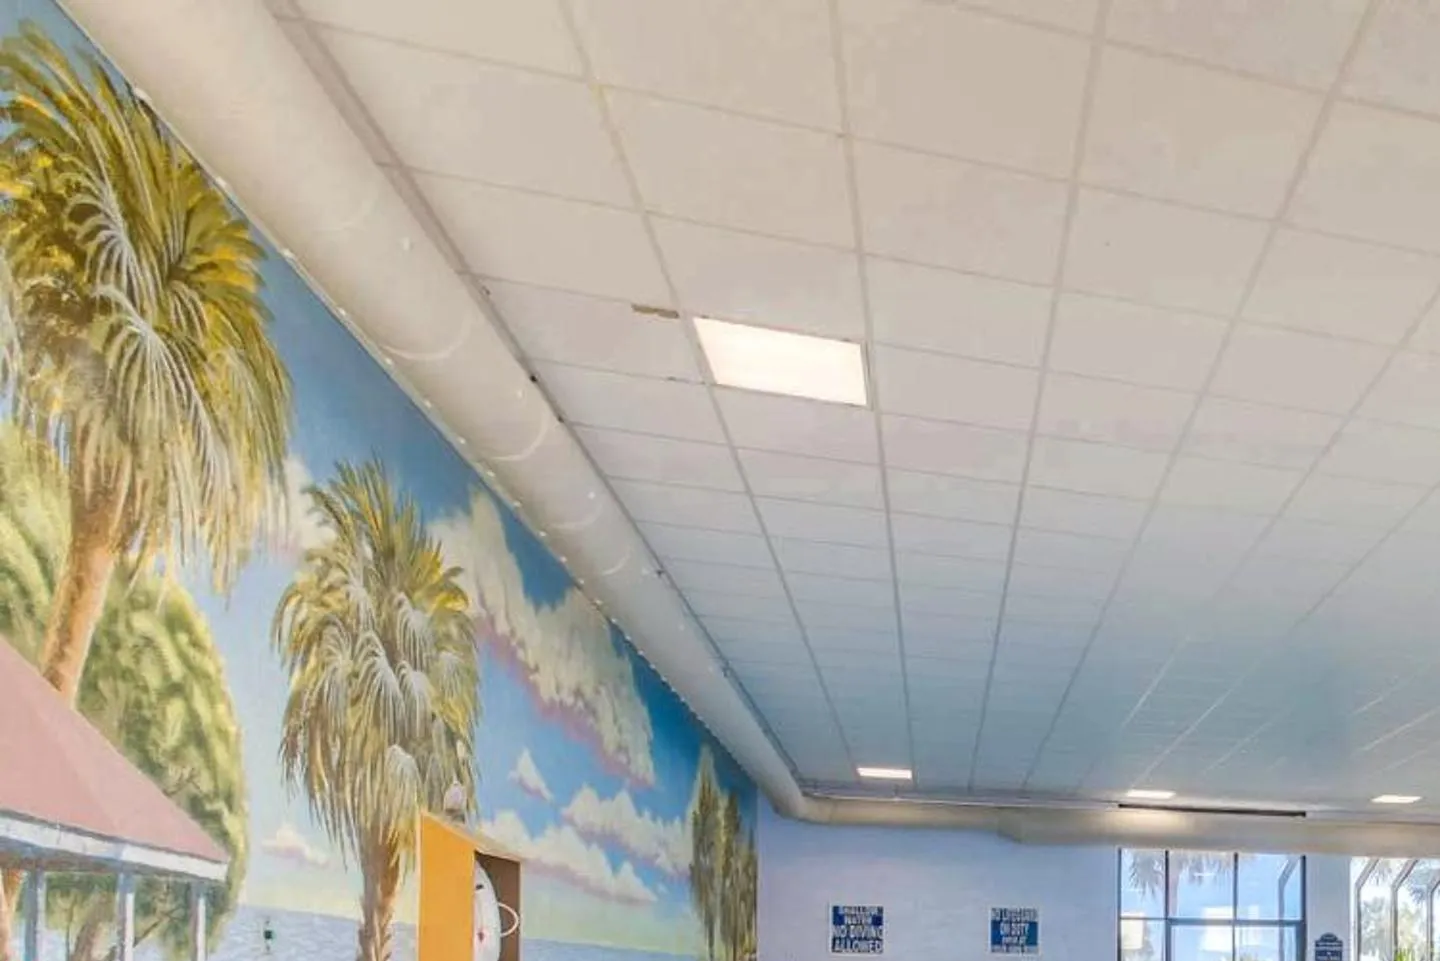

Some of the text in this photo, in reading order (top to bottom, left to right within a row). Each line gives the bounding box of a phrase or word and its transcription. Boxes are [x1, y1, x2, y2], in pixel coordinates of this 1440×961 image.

[832, 925, 883, 939] NO DIVING
[833, 939, 882, 953] ALLOWED
